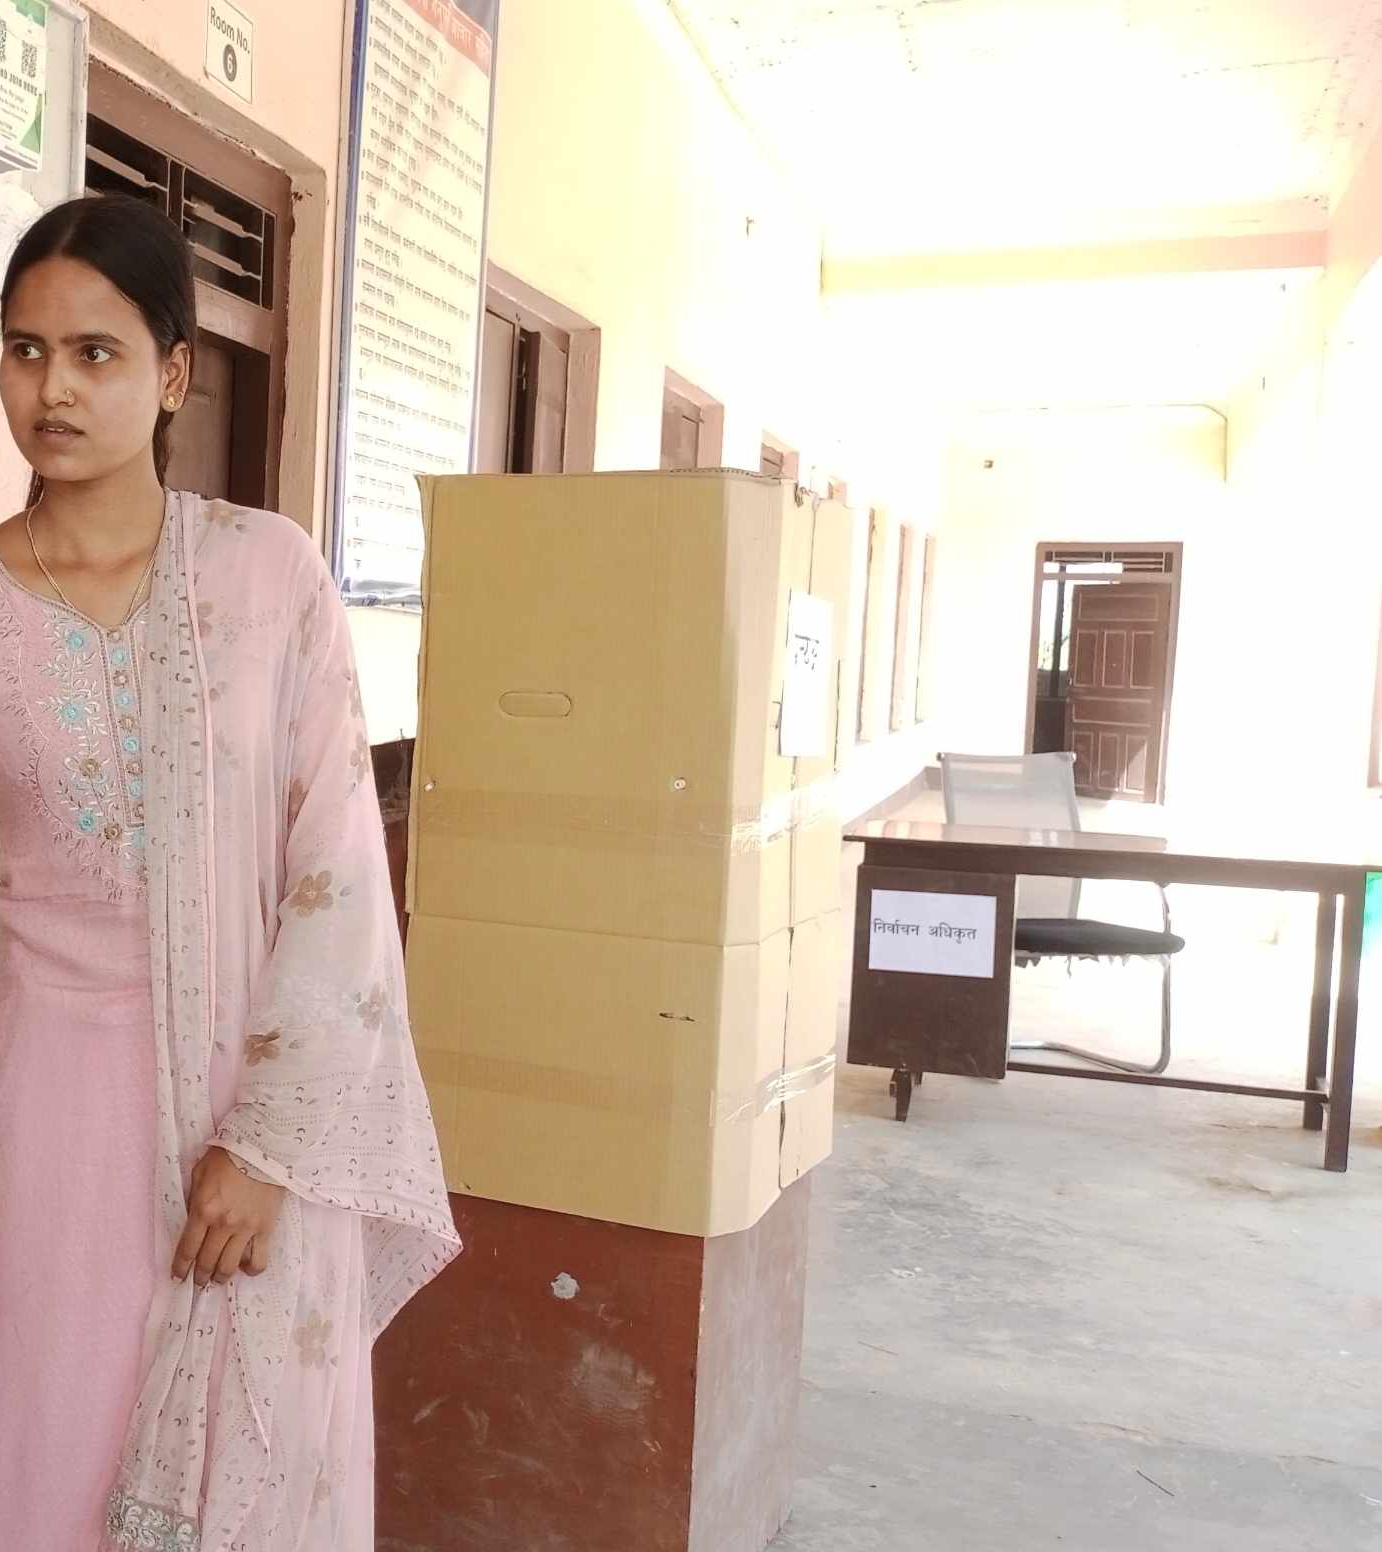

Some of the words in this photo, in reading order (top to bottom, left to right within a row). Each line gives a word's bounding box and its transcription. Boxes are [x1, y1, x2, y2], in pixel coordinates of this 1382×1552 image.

[210, 6, 235, 41] Room
[236, 27, 251, 54] No.
[873, 918, 920, 936] निर्वाचन
[928, 921, 977, 944] अधिकृत
